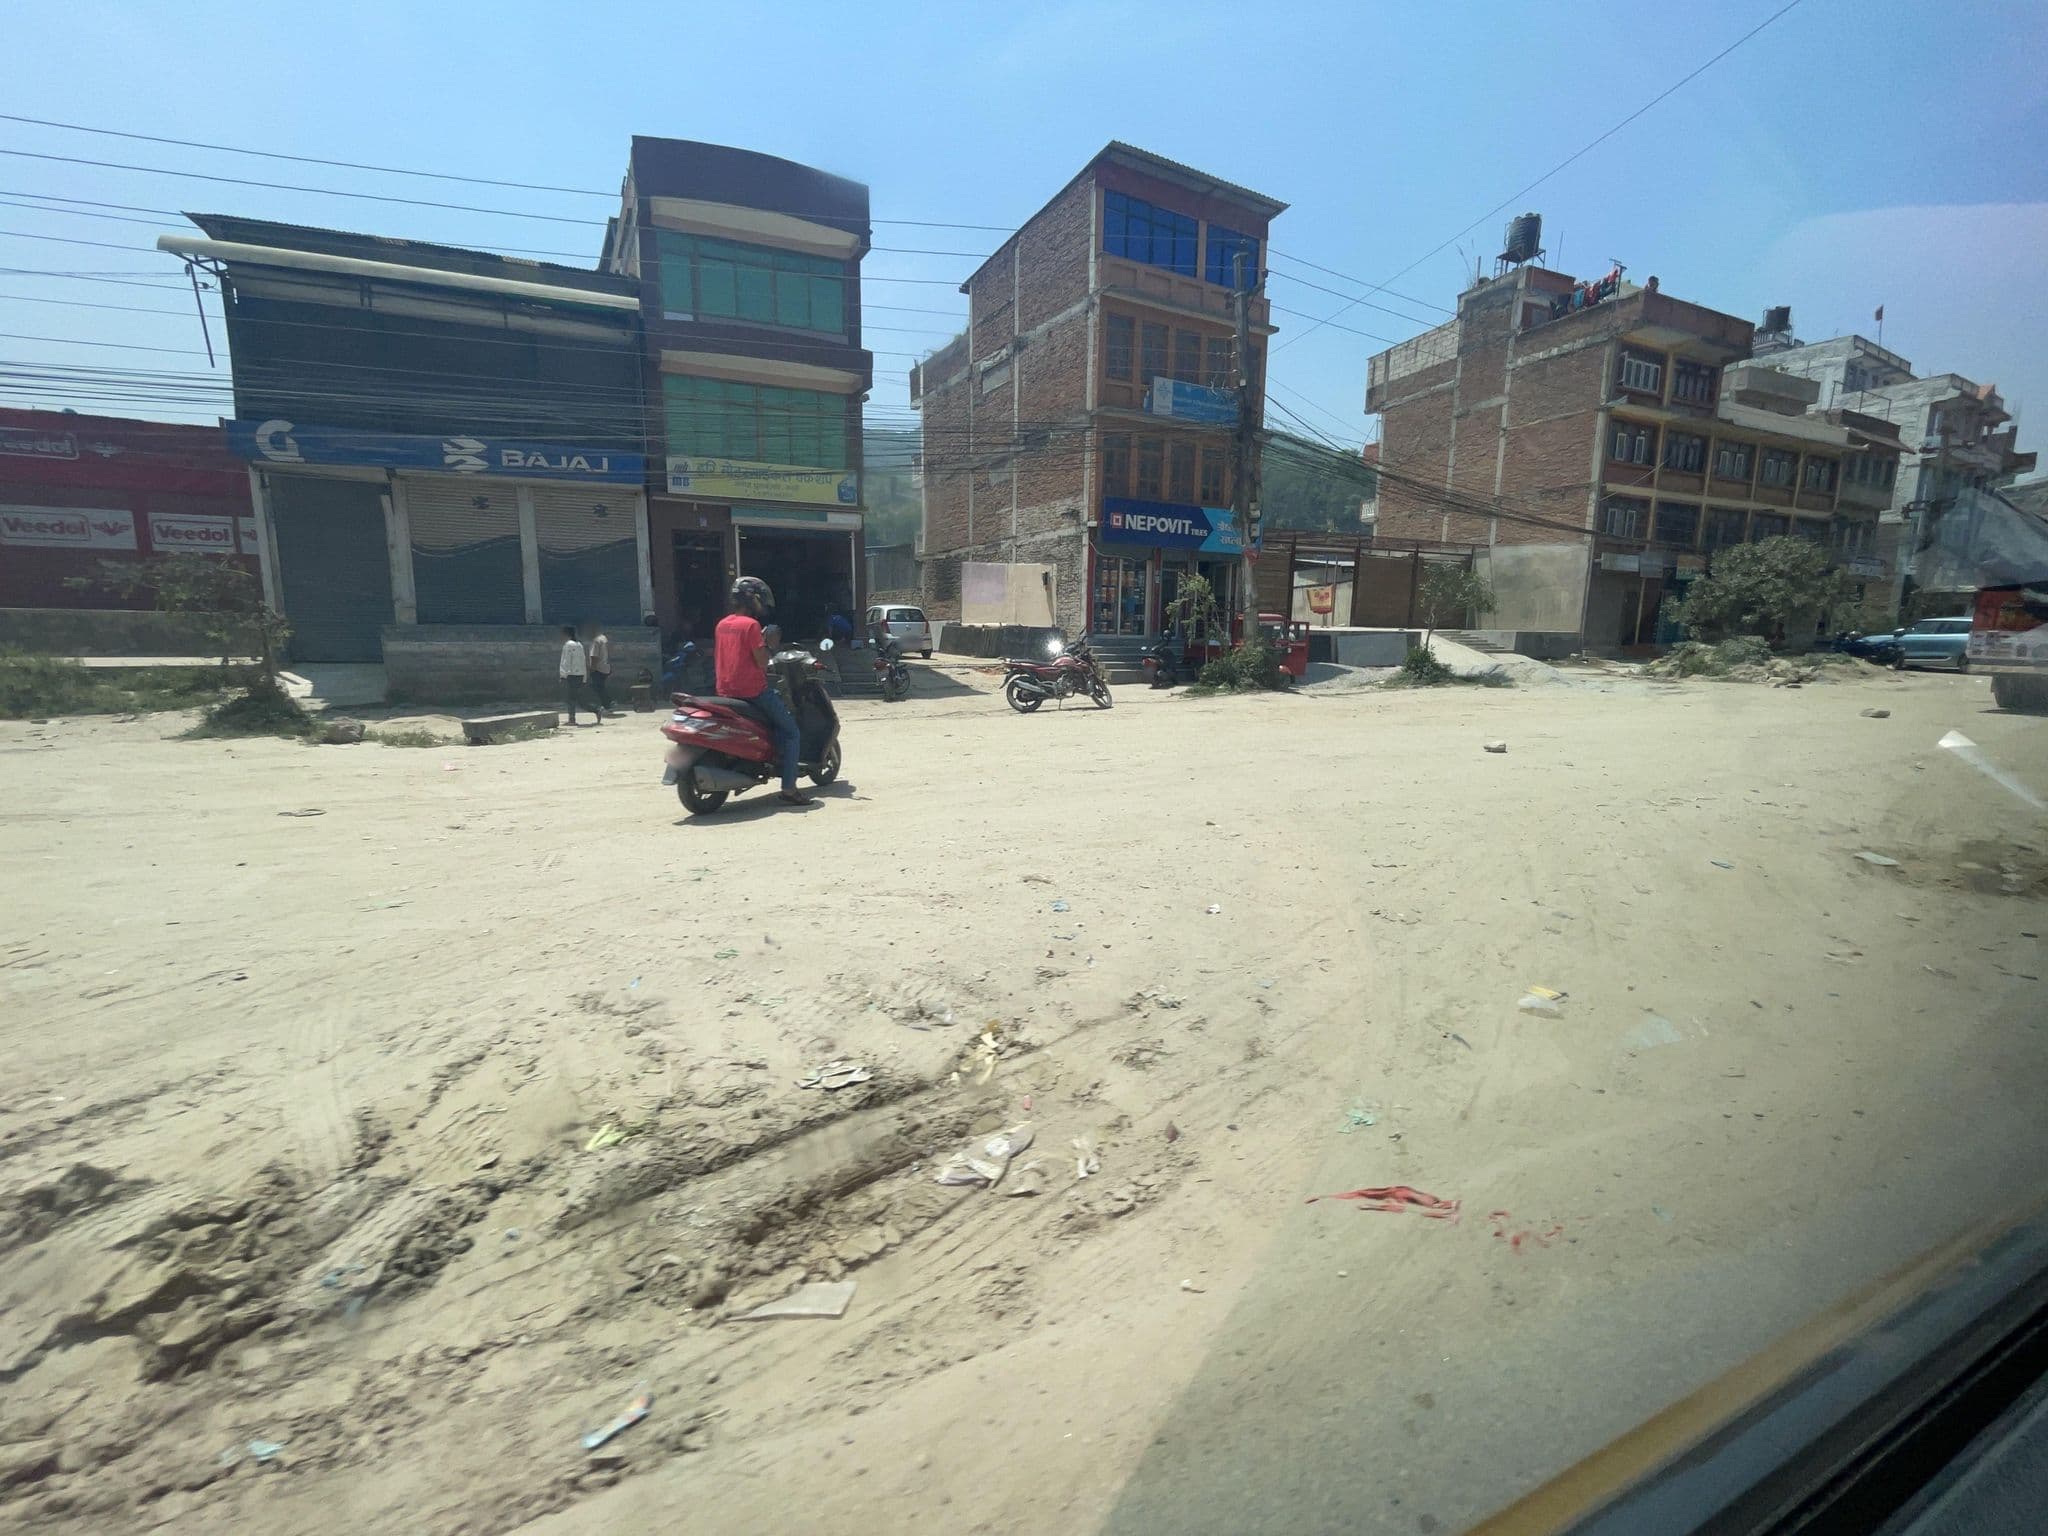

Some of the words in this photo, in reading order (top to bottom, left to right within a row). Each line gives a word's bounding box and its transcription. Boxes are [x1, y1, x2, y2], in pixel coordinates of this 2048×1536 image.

[501, 449, 609, 472] BAJAJ
[2, 516, 86, 535] Veedol
[155, 524, 230, 542] Veedol
[1125, 513, 1193, 535] NEPOVIT
